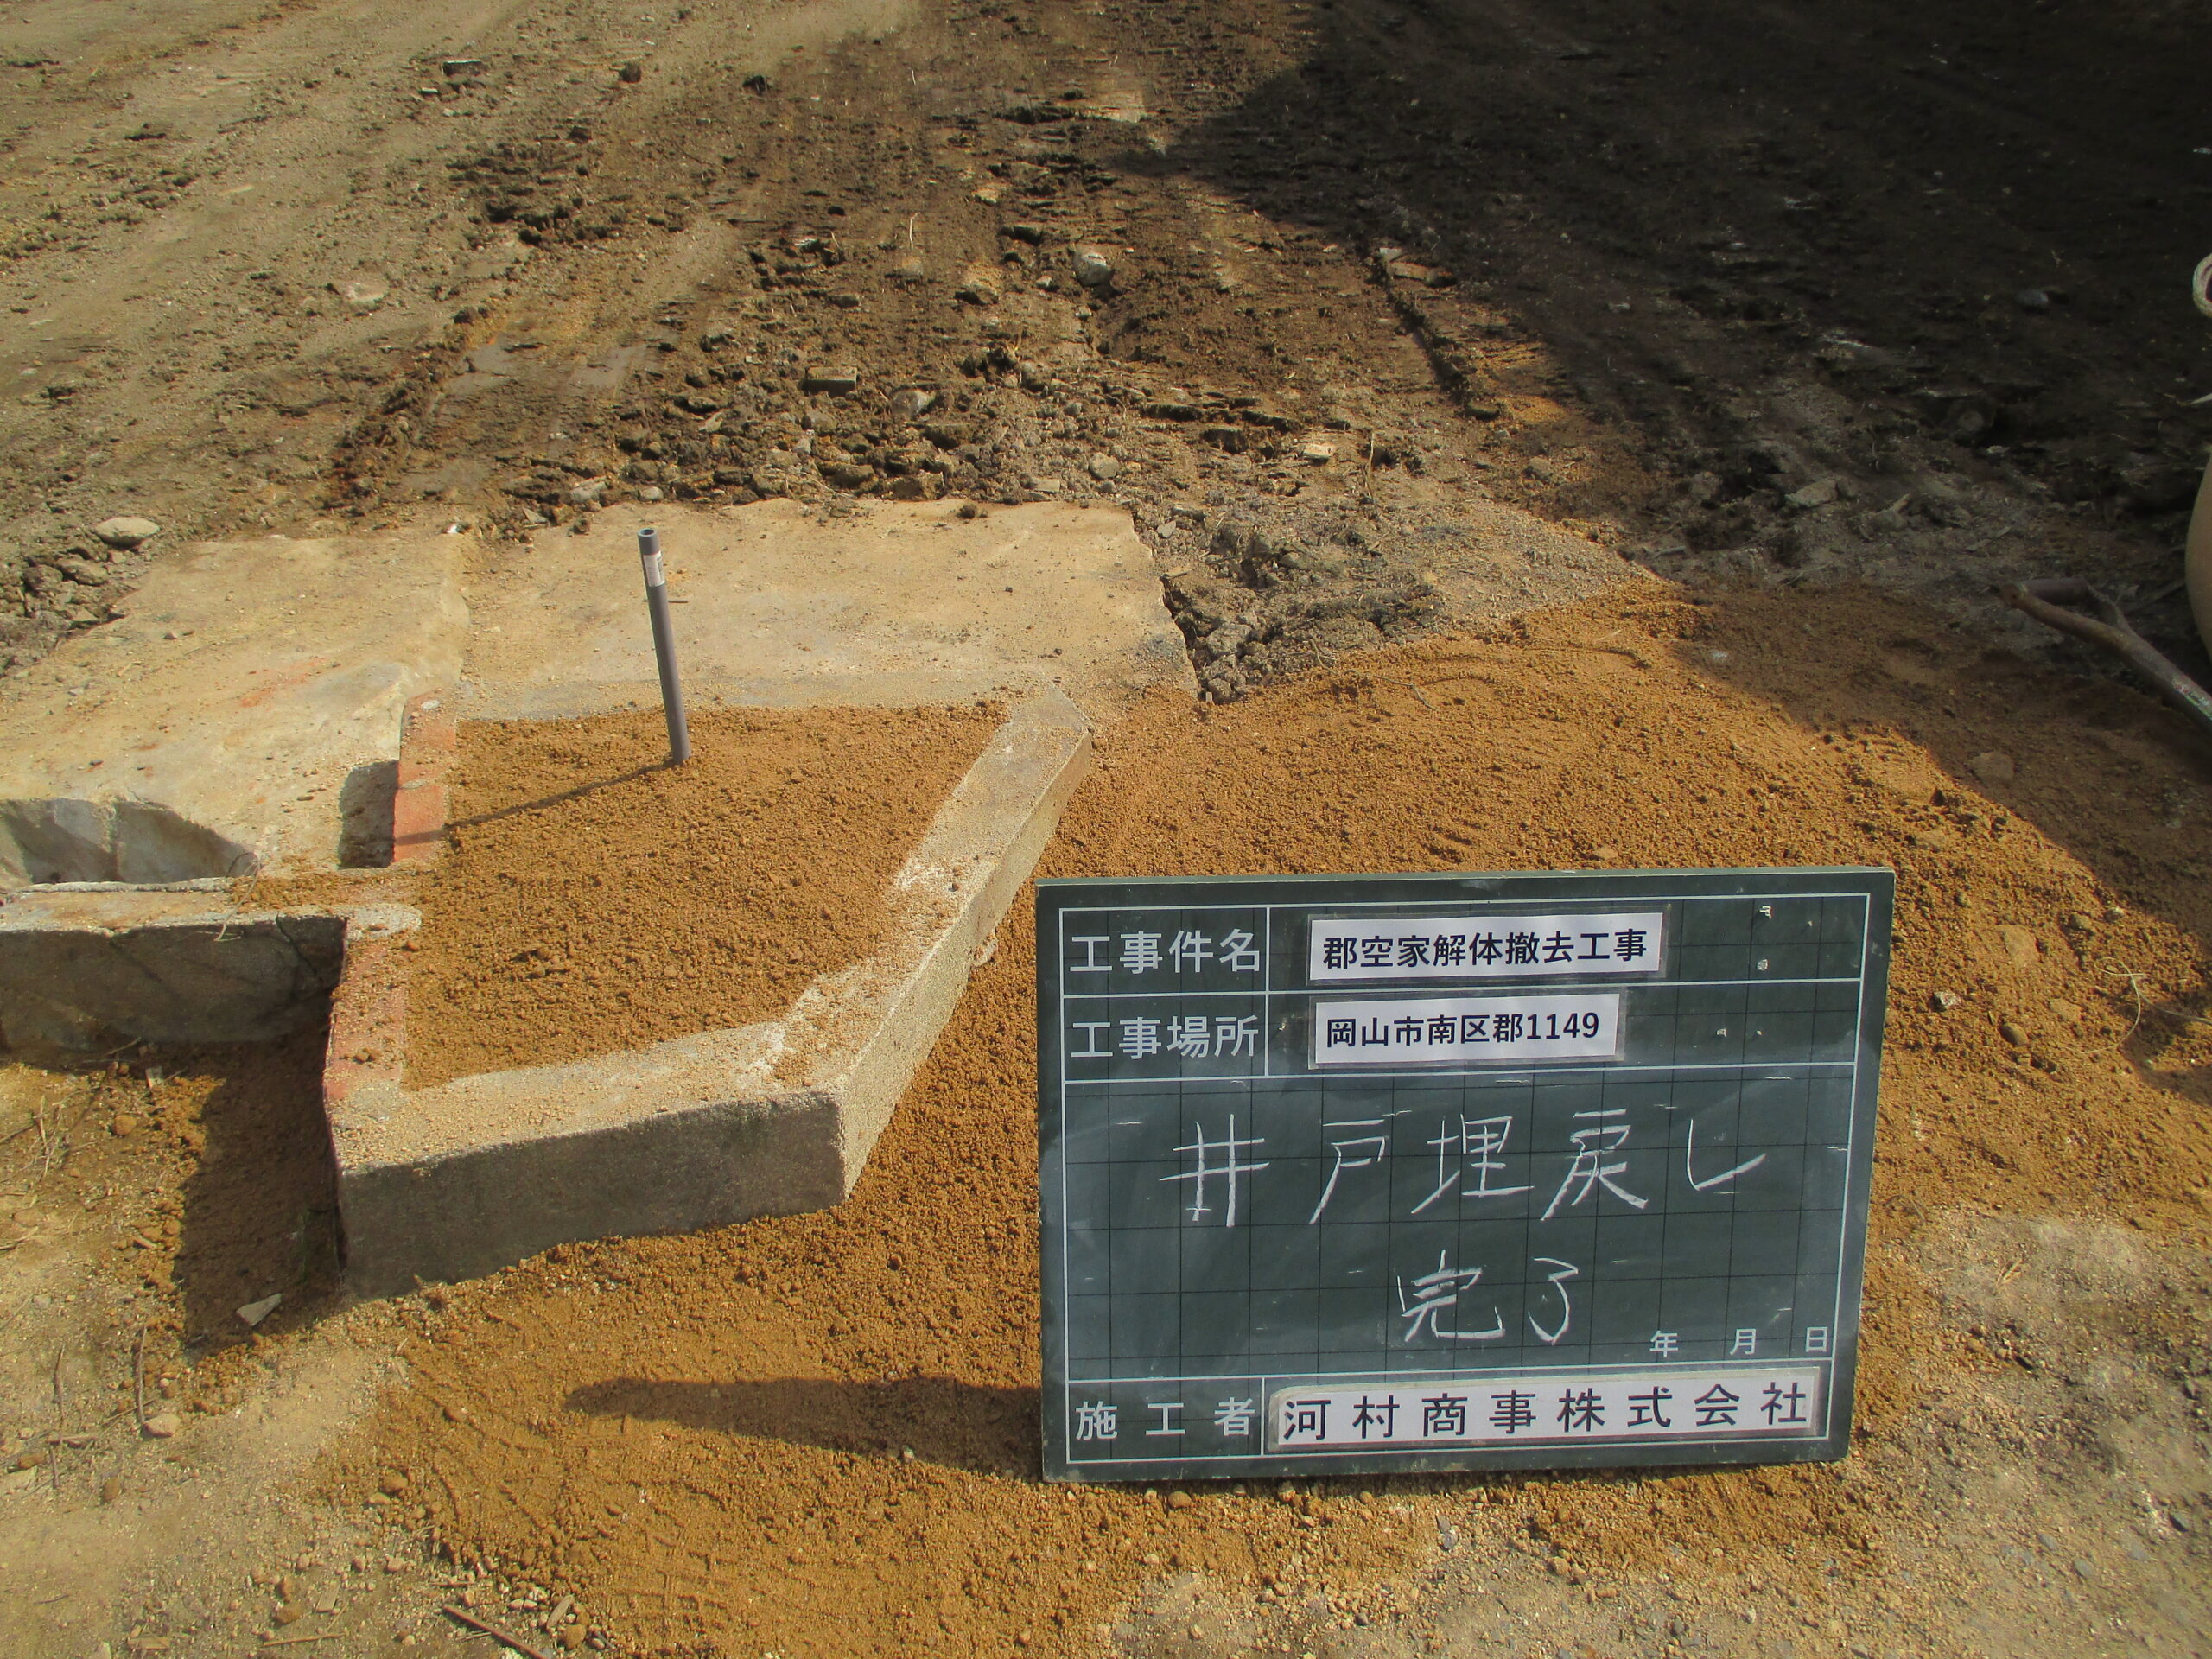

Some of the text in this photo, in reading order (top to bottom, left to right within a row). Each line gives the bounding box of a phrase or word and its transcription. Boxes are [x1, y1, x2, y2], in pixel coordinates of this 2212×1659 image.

[1070, 928, 1261, 975] 工事件名
[1322, 927, 1648, 970] 郡空家解体撤去工事
[1070, 1014, 1260, 1060] 工事場所
[1325, 1011, 1600, 1048] 岡山市南区郡1149
[1396, 1249, 1580, 1345] 完了
[1649, 1325, 1829, 1358] 年 月 日
[1074, 1395, 1257, 1442] 施工者
[1281, 1381, 1808, 1442] 河村商事株式会社
